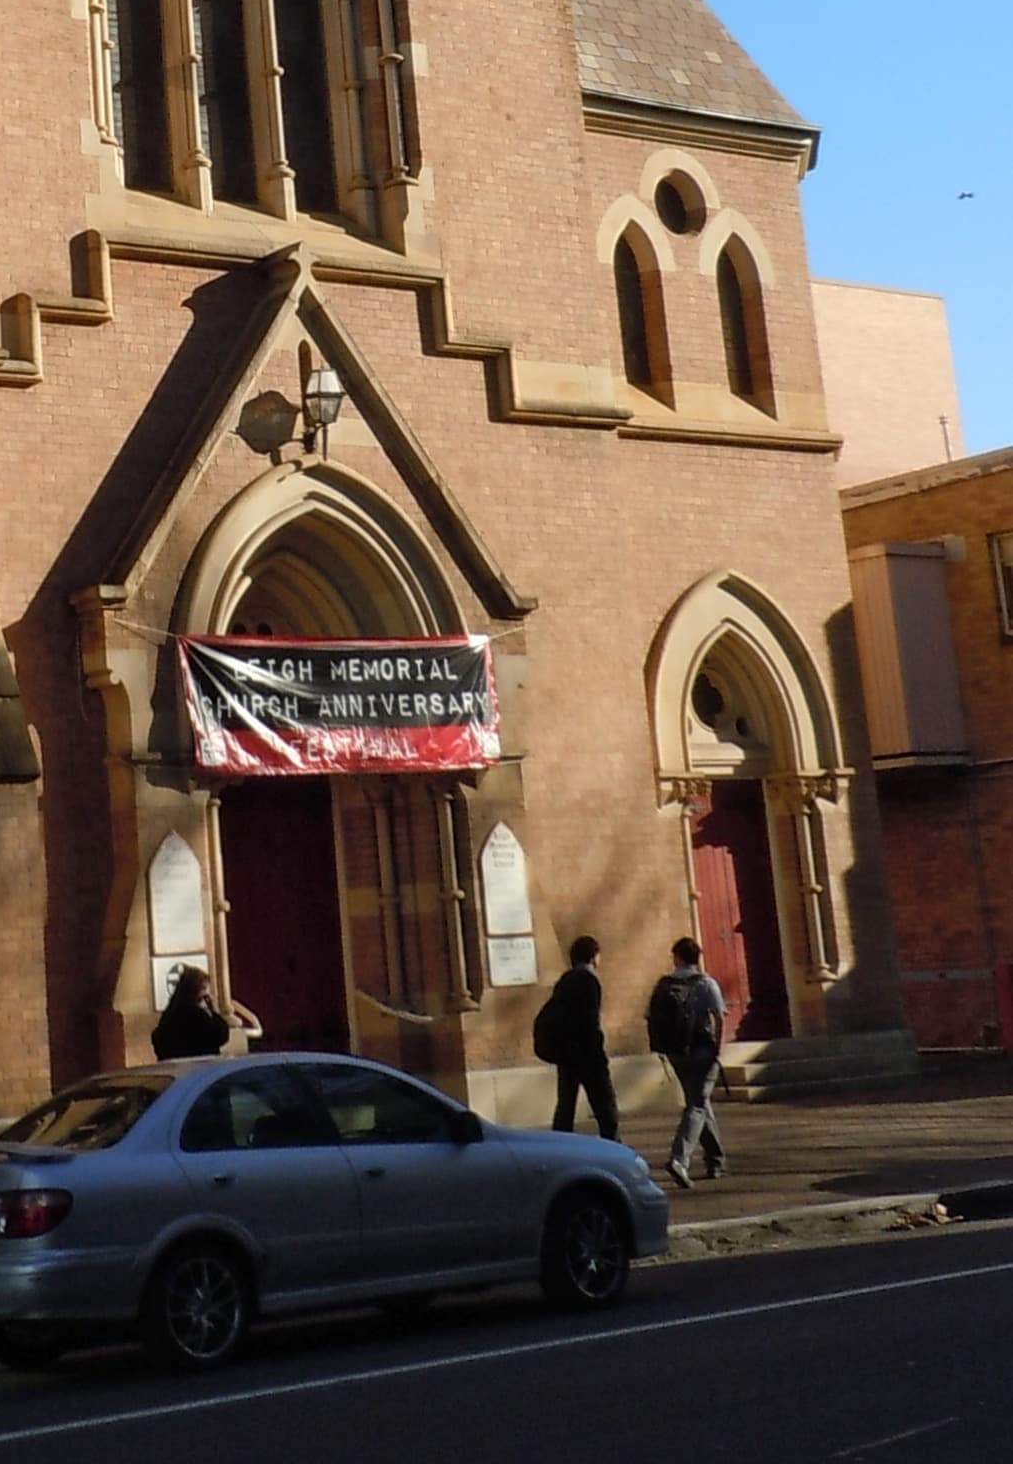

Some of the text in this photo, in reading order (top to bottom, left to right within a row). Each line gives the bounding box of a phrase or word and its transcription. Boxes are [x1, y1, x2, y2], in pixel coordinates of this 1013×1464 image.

[234, 657, 459, 682] LEIGH MEMORIAL
[200, 691, 488, 719] CHURCH ANNIVERSARY
